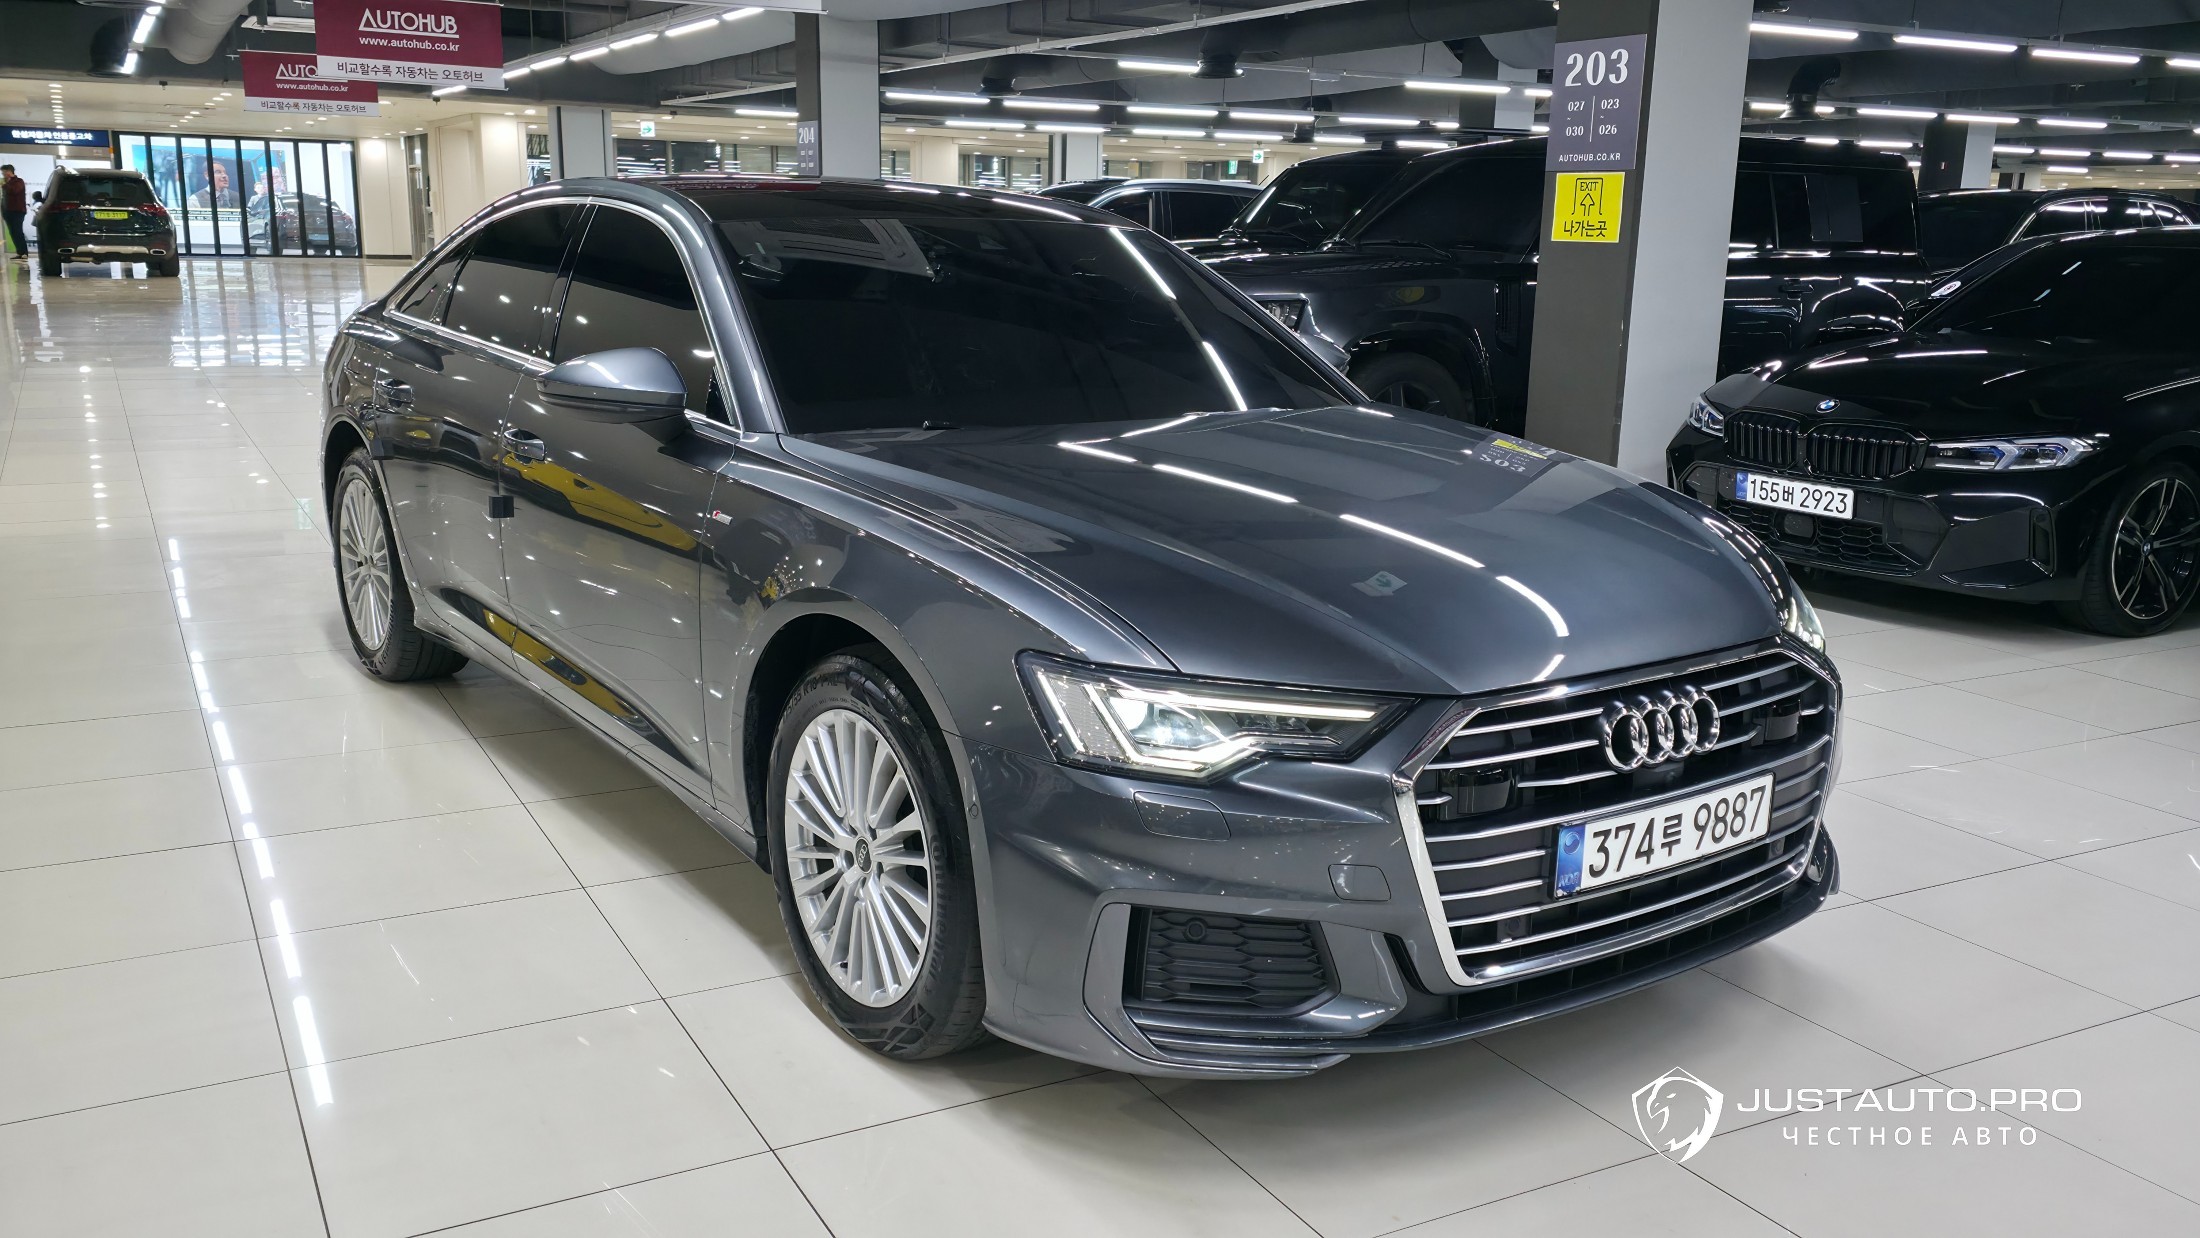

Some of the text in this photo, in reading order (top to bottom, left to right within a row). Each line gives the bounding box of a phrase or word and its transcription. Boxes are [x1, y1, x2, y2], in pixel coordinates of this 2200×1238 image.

[358, 8, 459, 38] AUTOHUB
[359, 37, 460, 51] www.autohub.co.kr
[276, 63, 318, 80] AUTO
[337, 62, 484, 83] 비교할수록 자동차는 오토허브
[1565, 48, 1629, 87] 203
[276, 82, 349, 92] www.autohub.co.kr
[260, 101, 367, 114] 비교할수록 자동차는 오토허브
[1568, 101, 1585, 111] 027
[1601, 98, 1620, 110] 023
[799, 128, 814, 144] 204
[1566, 125, 1584, 136] 030
[1599, 124, 1617, 135] 026
[1559, 152, 1621, 162] AUTOHUB.CO.KR
[1580, 181, 1599, 191] EXIT
[1564, 220, 1607, 237] 나가는곳
[1750, 478, 1848, 514] 155버 2923
[1588, 784, 1767, 879] 374루 9887
